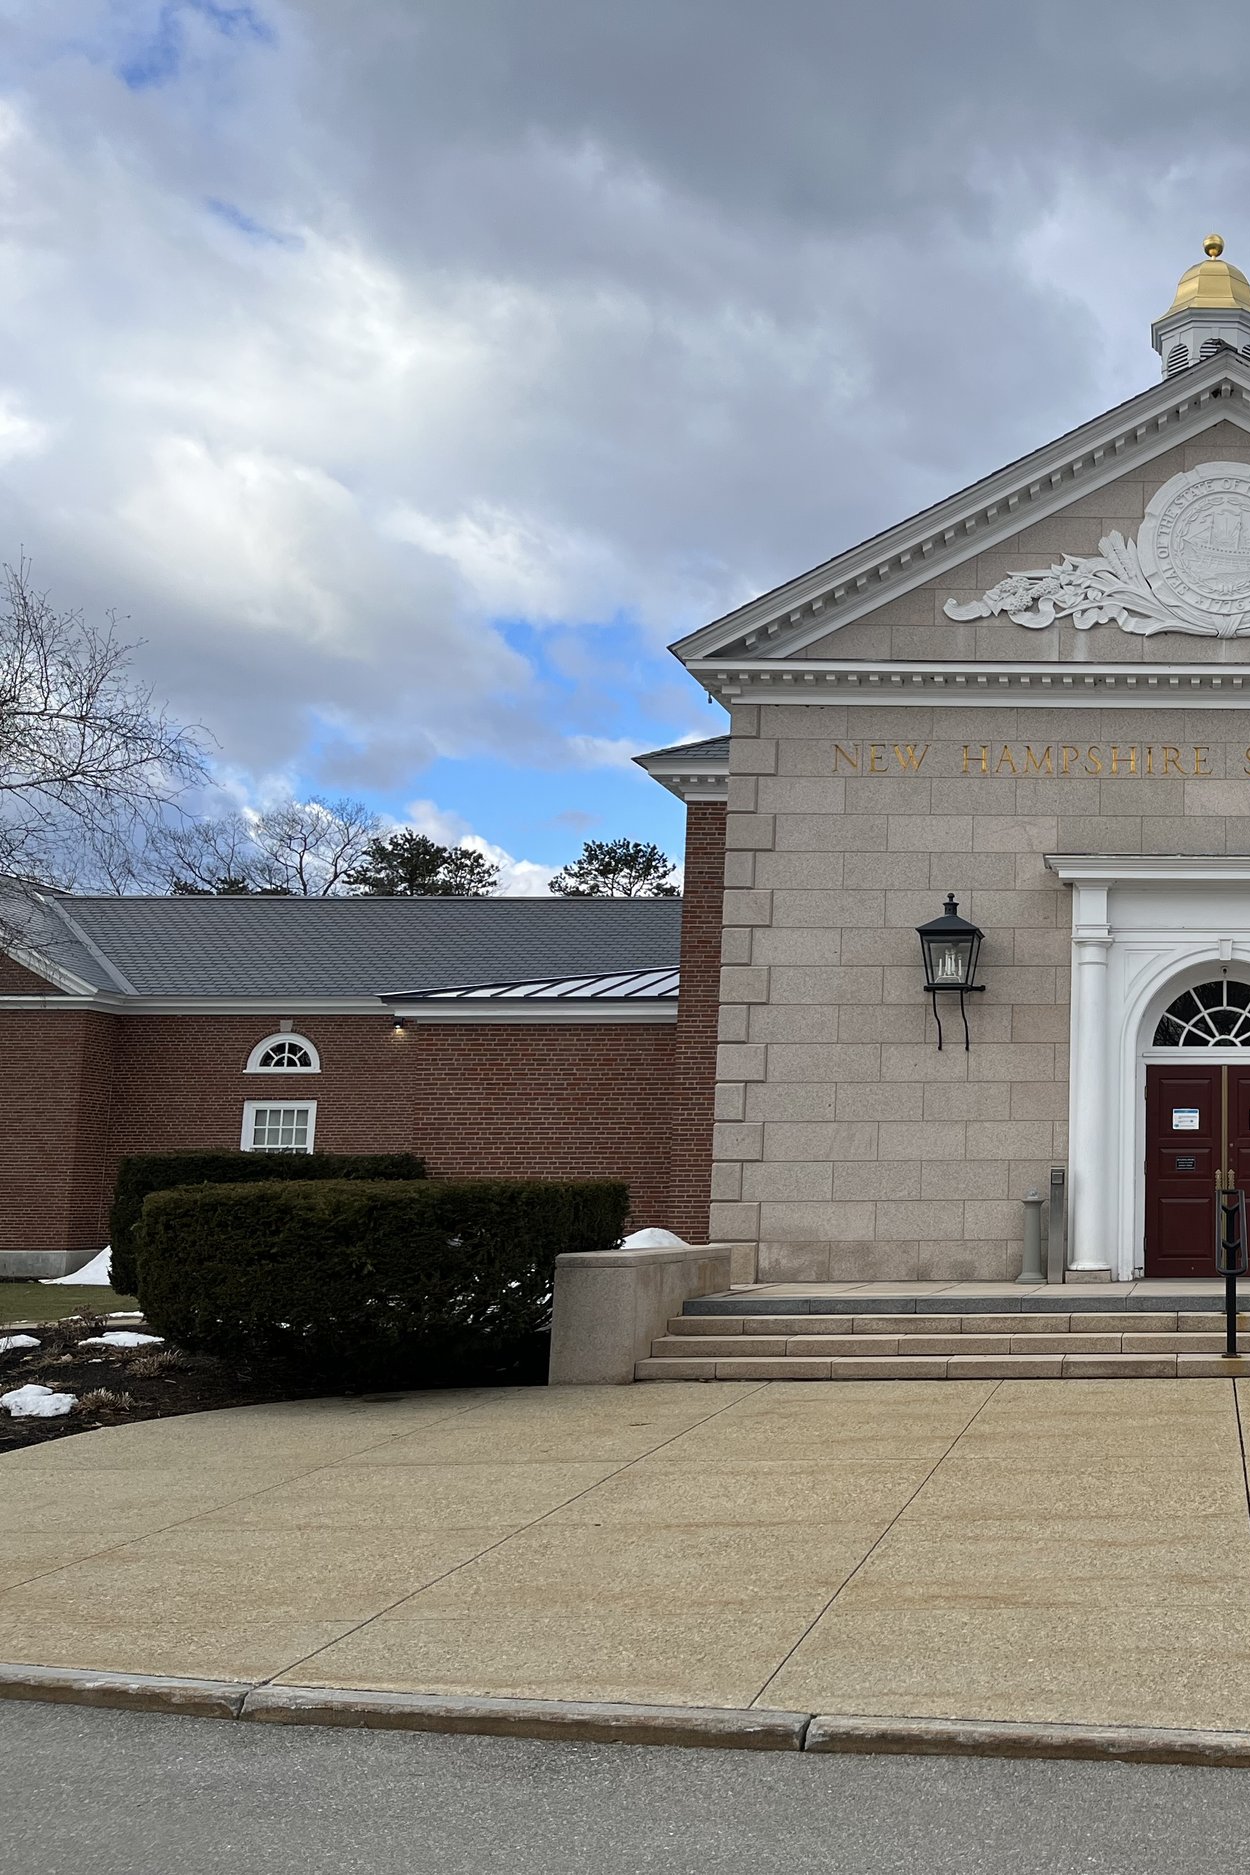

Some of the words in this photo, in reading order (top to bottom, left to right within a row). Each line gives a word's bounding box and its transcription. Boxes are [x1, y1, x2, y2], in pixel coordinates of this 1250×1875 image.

[1174, 480, 1215, 507] STATE
[1222, 479, 1239, 491] OF
[1158, 509, 1178, 537] THE
[1157, 542, 1169, 559] OF
[1162, 567, 1189, 596] SEAL
[1205, 599, 1245, 611] 1776
[831, 743, 932, 774] NEW
[960, 745, 1213, 776] HAMPSHIRE
